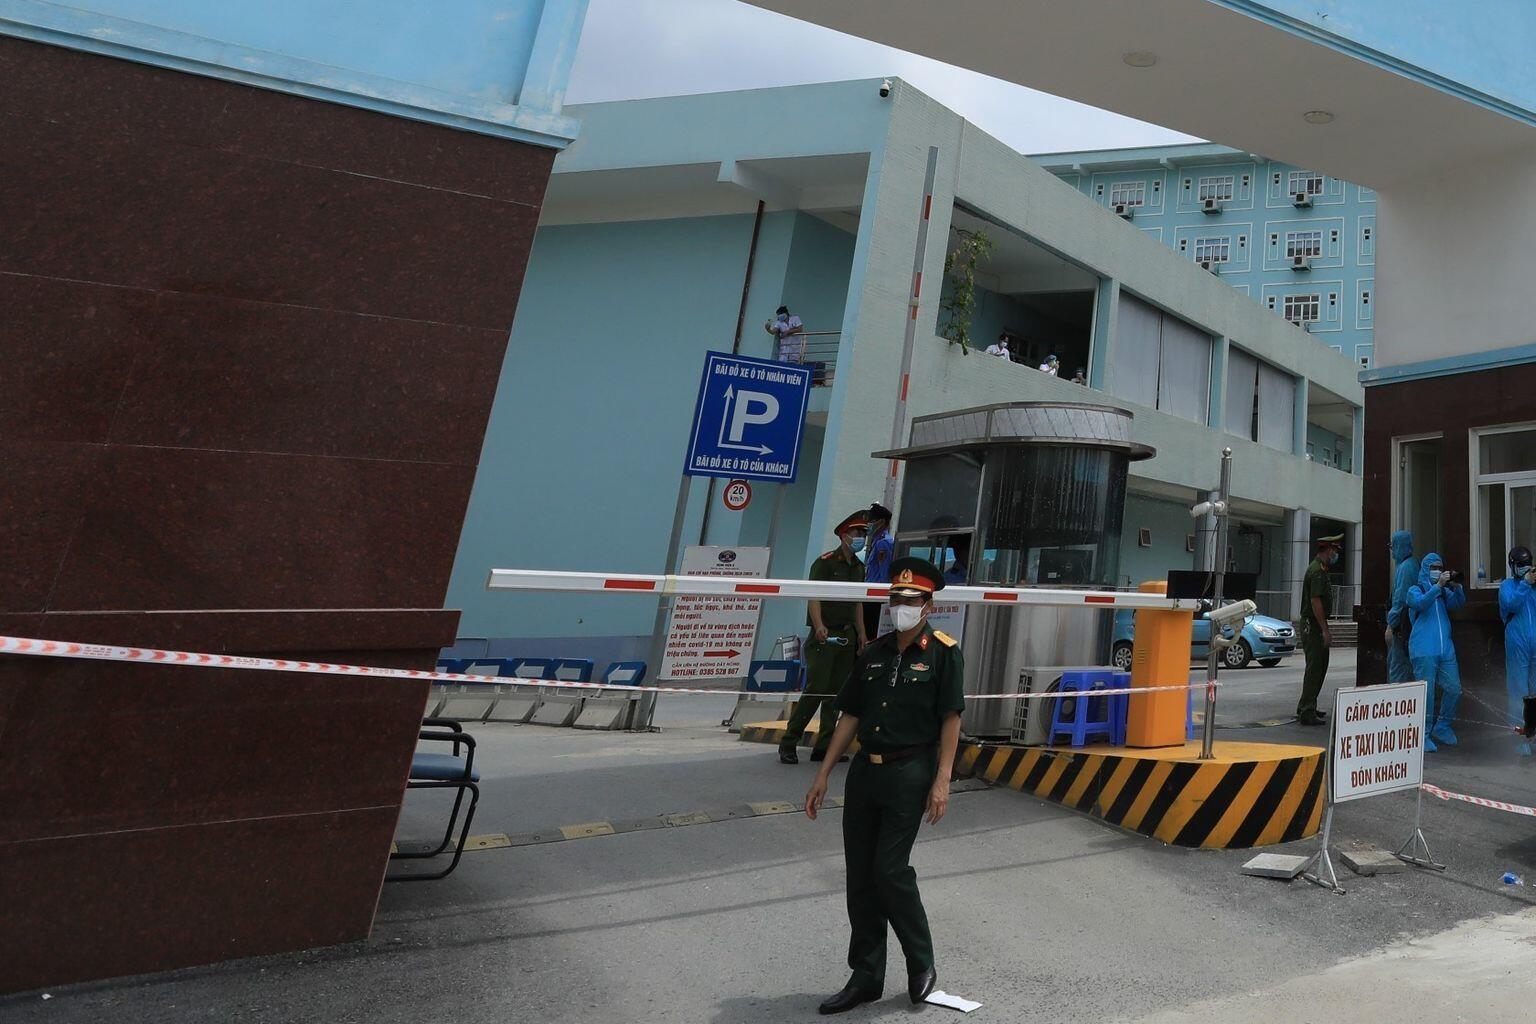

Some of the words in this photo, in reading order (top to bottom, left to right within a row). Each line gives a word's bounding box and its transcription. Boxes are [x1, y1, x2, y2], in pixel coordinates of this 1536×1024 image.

[715, 363, 728, 375] BÃI
[728, 364, 739, 376] ĐỖ
[740, 367, 749, 378] XE
[750, 368, 756, 379] Ô
[757, 369, 766, 380] TÔ
[766, 371, 785, 383] NHÂN
[786, 374, 802, 386] VIÊN
[728, 389, 780, 442] P
[696, 455, 709, 467] BÃI
[710, 454, 720, 467] ĐỖ
[722, 458, 732, 469] XE
[733, 457, 738, 469] Ô
[740, 458, 749, 470] TÔ
[750, 457, 764, 471] CỦA
[765, 458, 789, 474] KHÁCH
[733, 486, 744, 495] 20
[671, 668, 698, 676] HOTLINE:
[1345, 700, 1369, 723] CẤM
[1372, 699, 1392, 719] CÁC
[1394, 698, 1417, 718] LOẠI
[1340, 736, 1352, 759] XE
[1355, 733, 1375, 757] TAXI
[1377, 726, 1395, 753] VÀO
[1398, 723, 1419, 754] VIỆN
[1351, 766, 1372, 788] ĐÓN
[1374, 761, 1407, 783] KHÁCH
